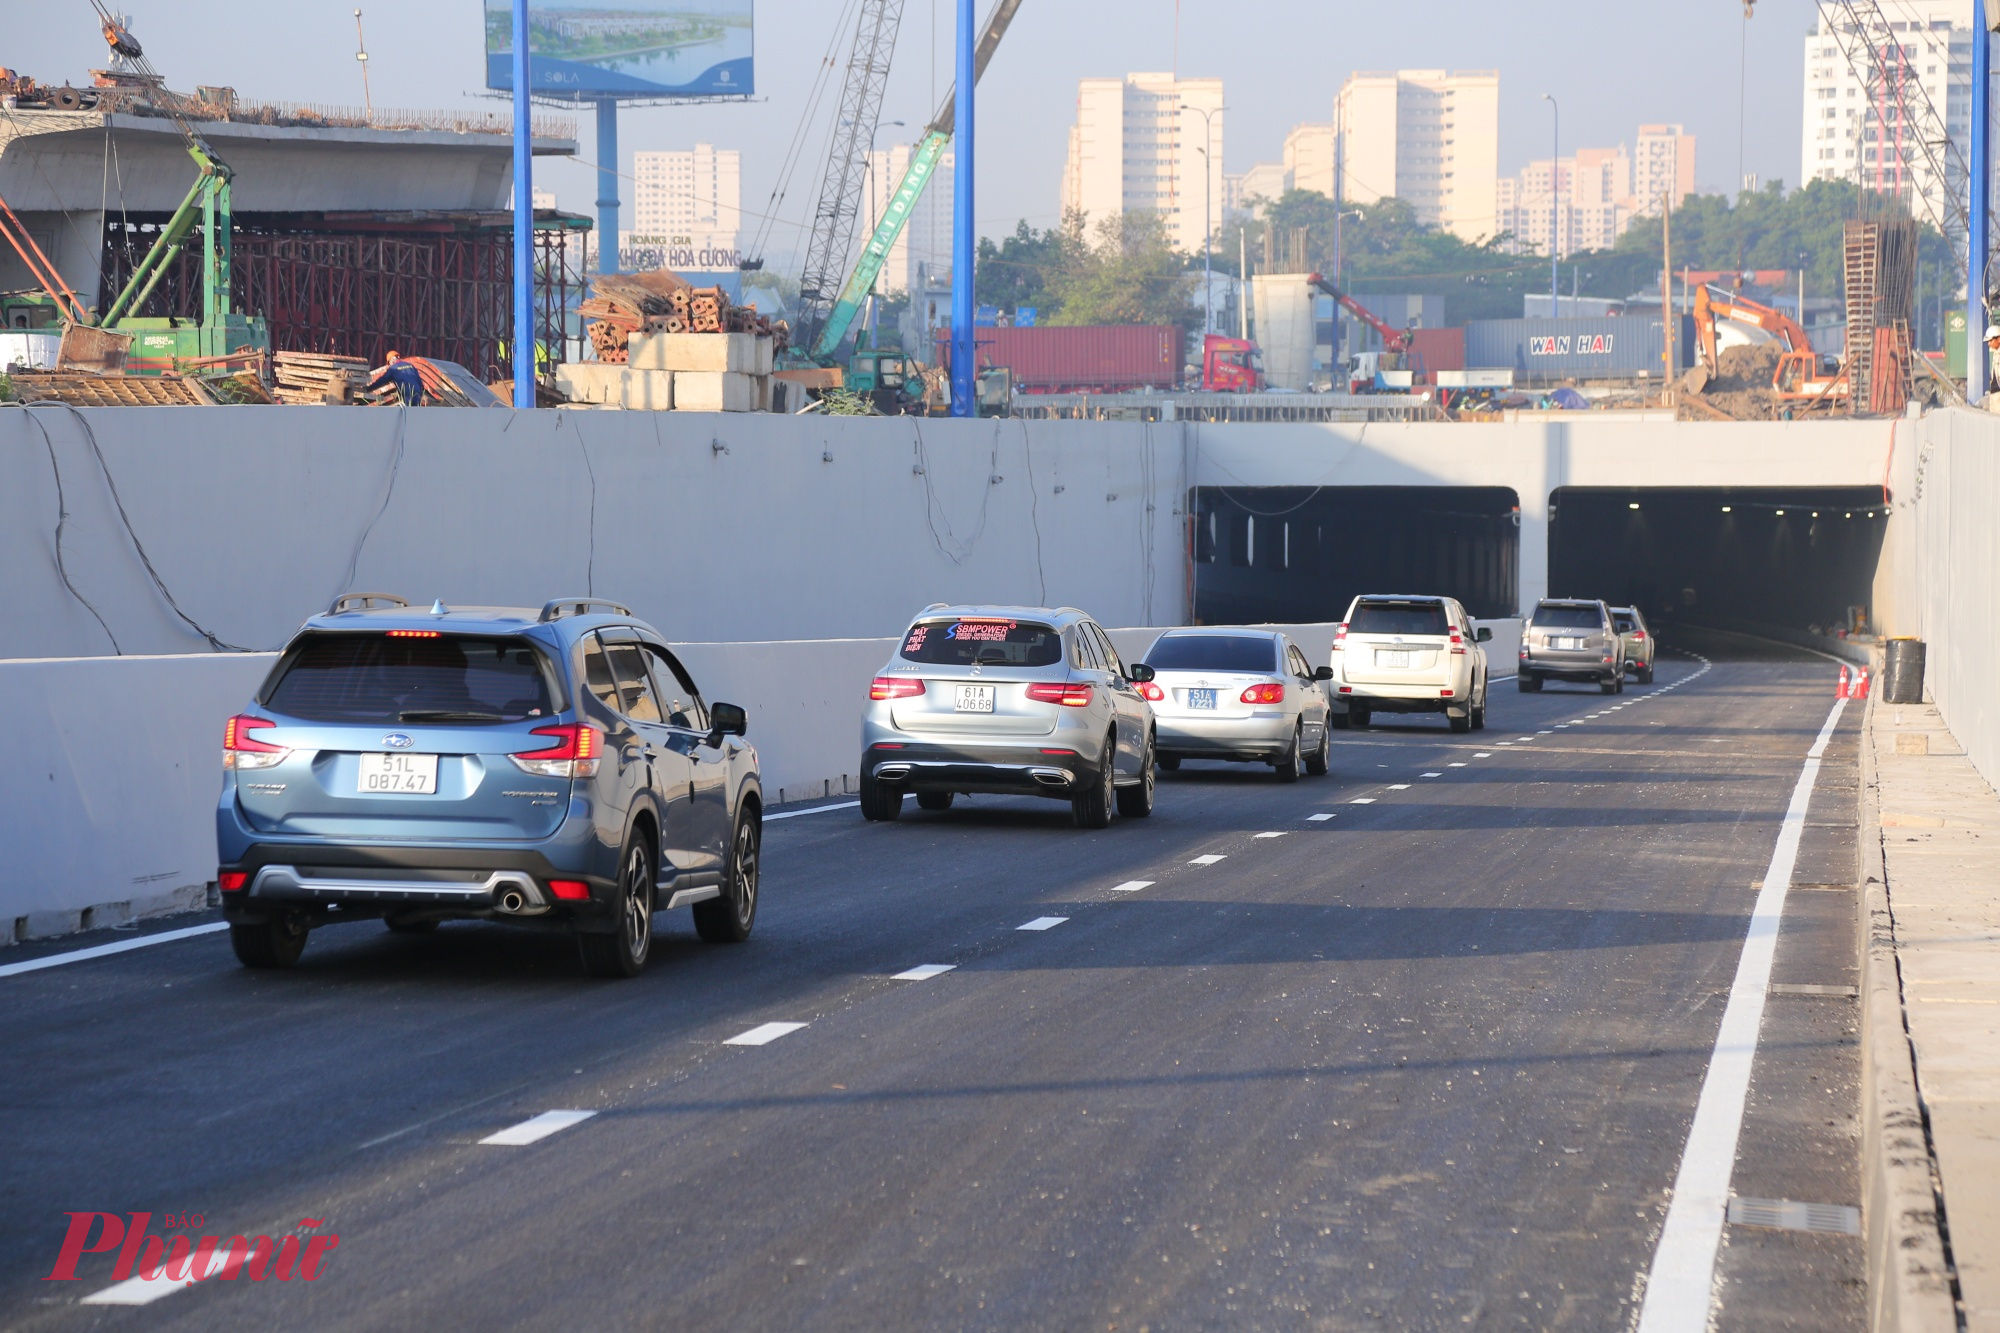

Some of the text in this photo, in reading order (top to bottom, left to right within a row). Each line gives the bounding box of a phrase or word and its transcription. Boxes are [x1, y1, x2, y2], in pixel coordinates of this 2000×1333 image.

[673, 235, 692, 245] GIA
[669, 248, 695, 267] HOA
[1530, 334, 1614, 355] WAN HAI
[956, 625, 1008, 634] SBMPOWER
[965, 687, 984, 698] 61A
[956, 699, 992, 710] 406.68
[383, 757, 414, 772] 51L
[368, 774, 427, 790] 087.47
